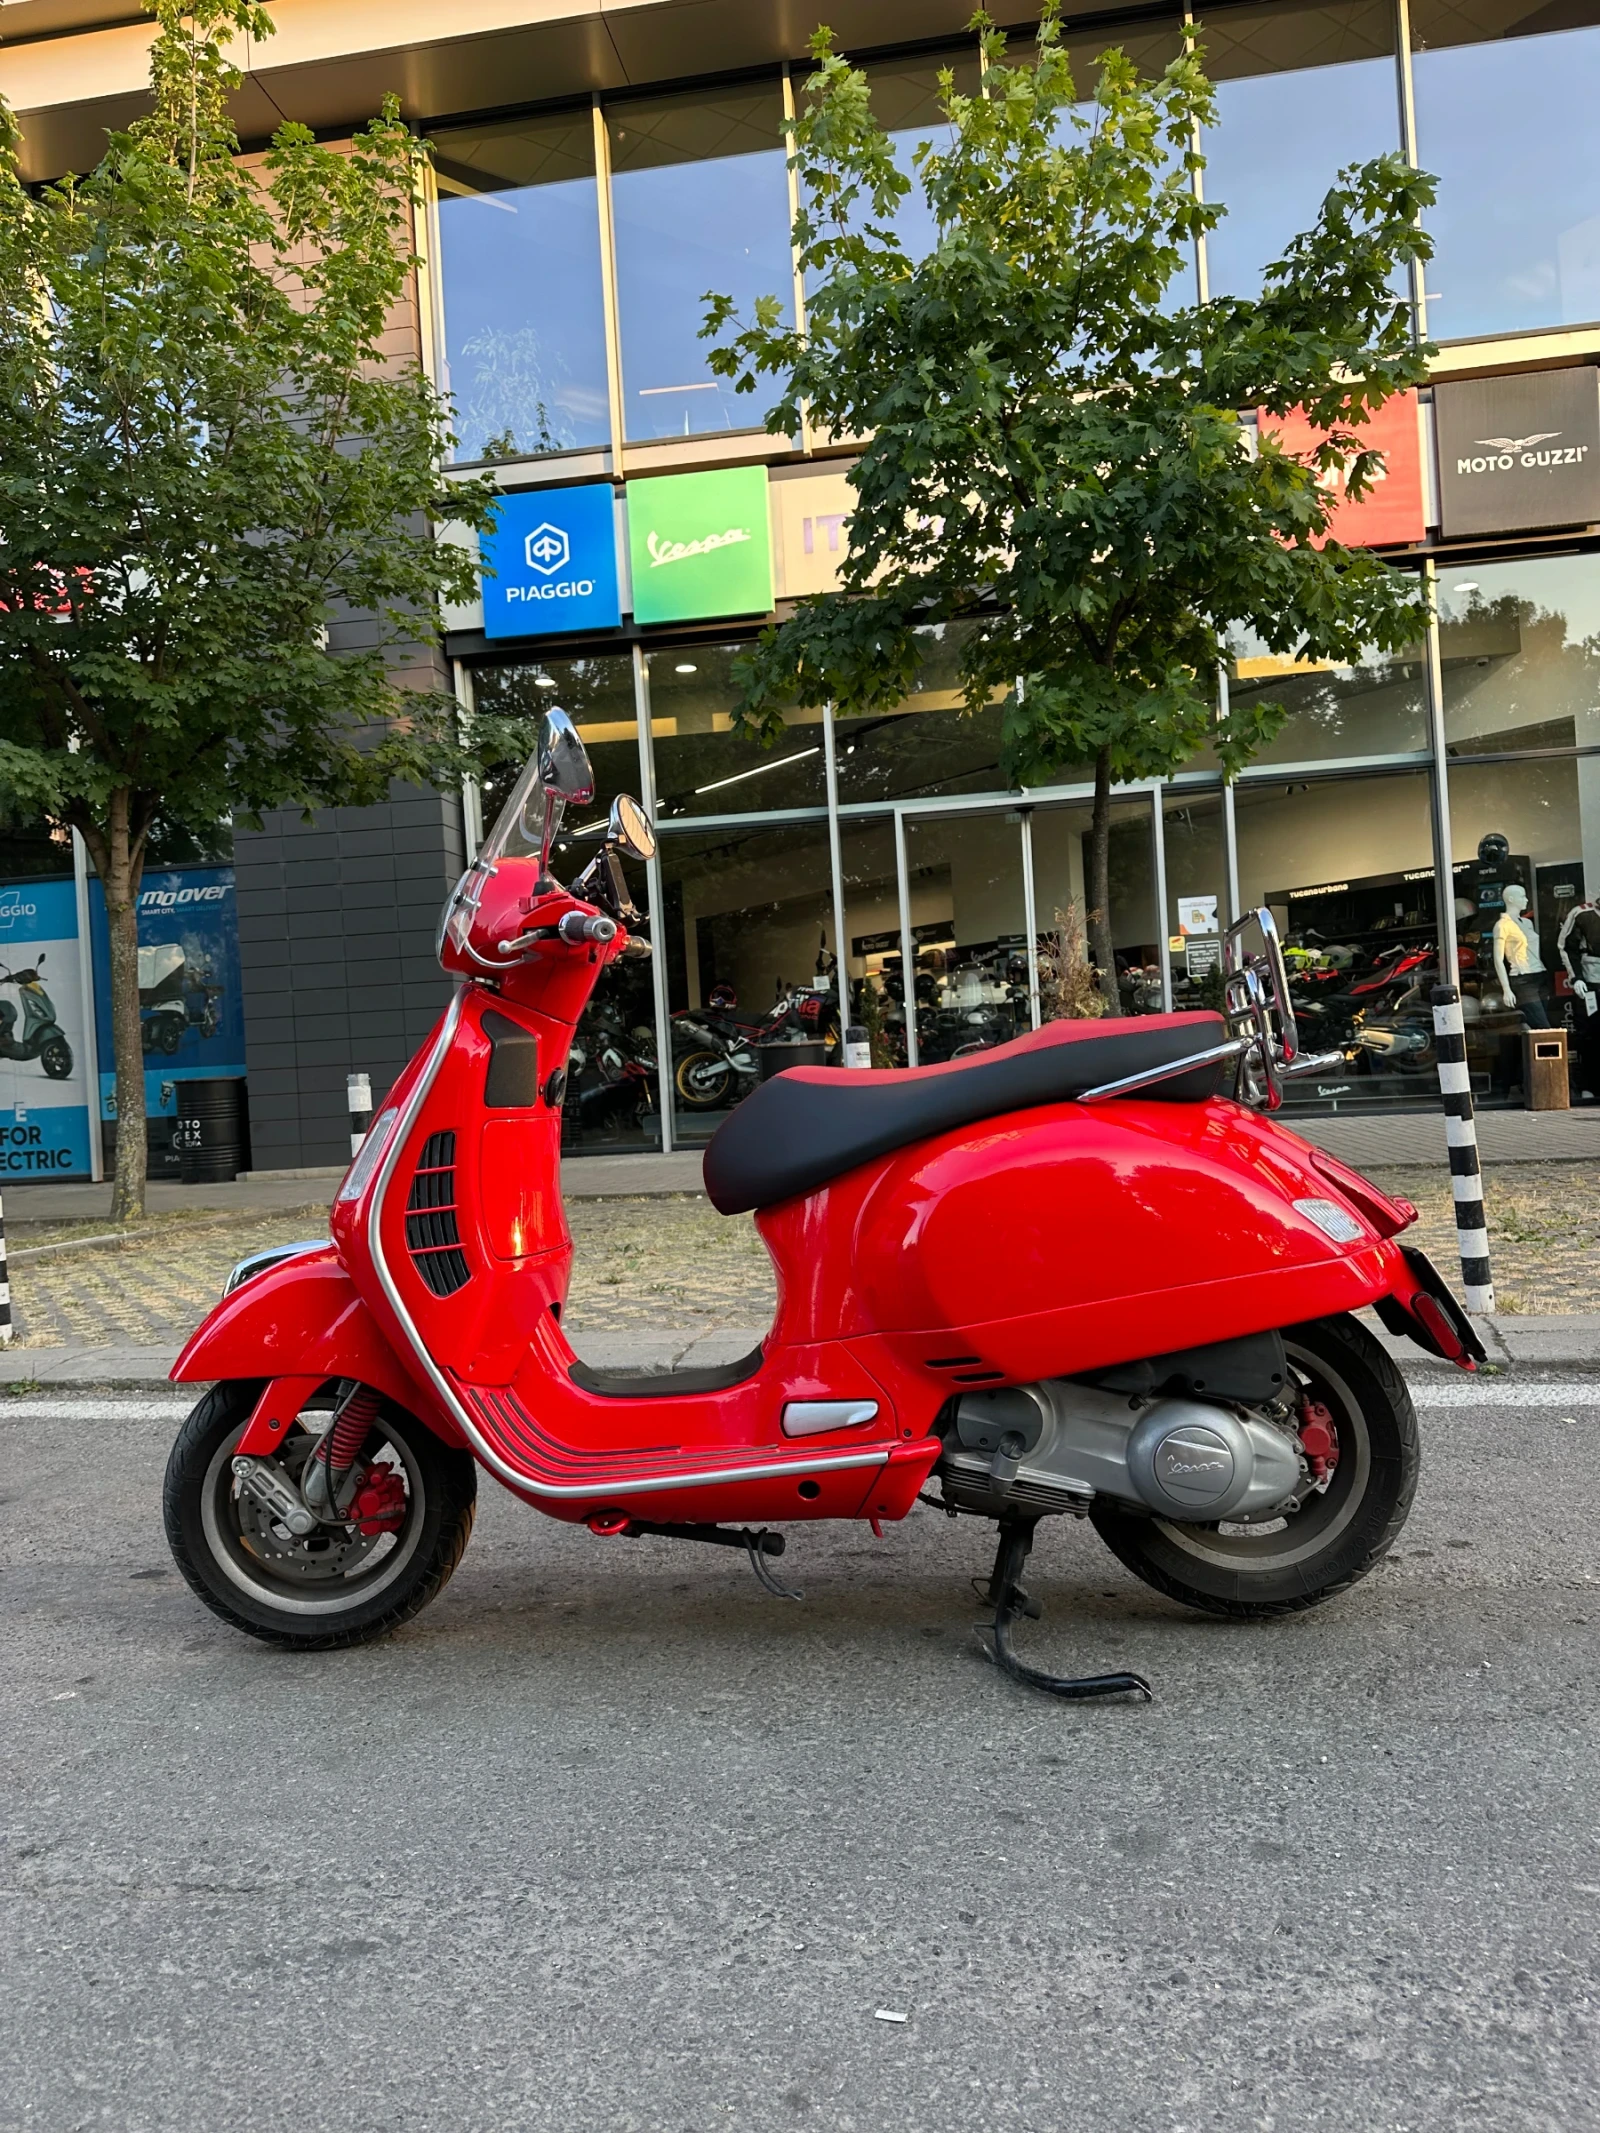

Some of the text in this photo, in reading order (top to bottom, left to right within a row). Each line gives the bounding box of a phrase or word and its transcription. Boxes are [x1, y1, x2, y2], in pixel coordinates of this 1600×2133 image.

[1457, 447, 1583, 475] MOTO GUZZI
[646, 527, 752, 568] Vespa
[505, 579, 594, 603] PIAGGIO
[138, 885, 234, 907] moover
[0, 903, 37, 918] GGIO
[1167, 1454, 1225, 1475] Vespa
